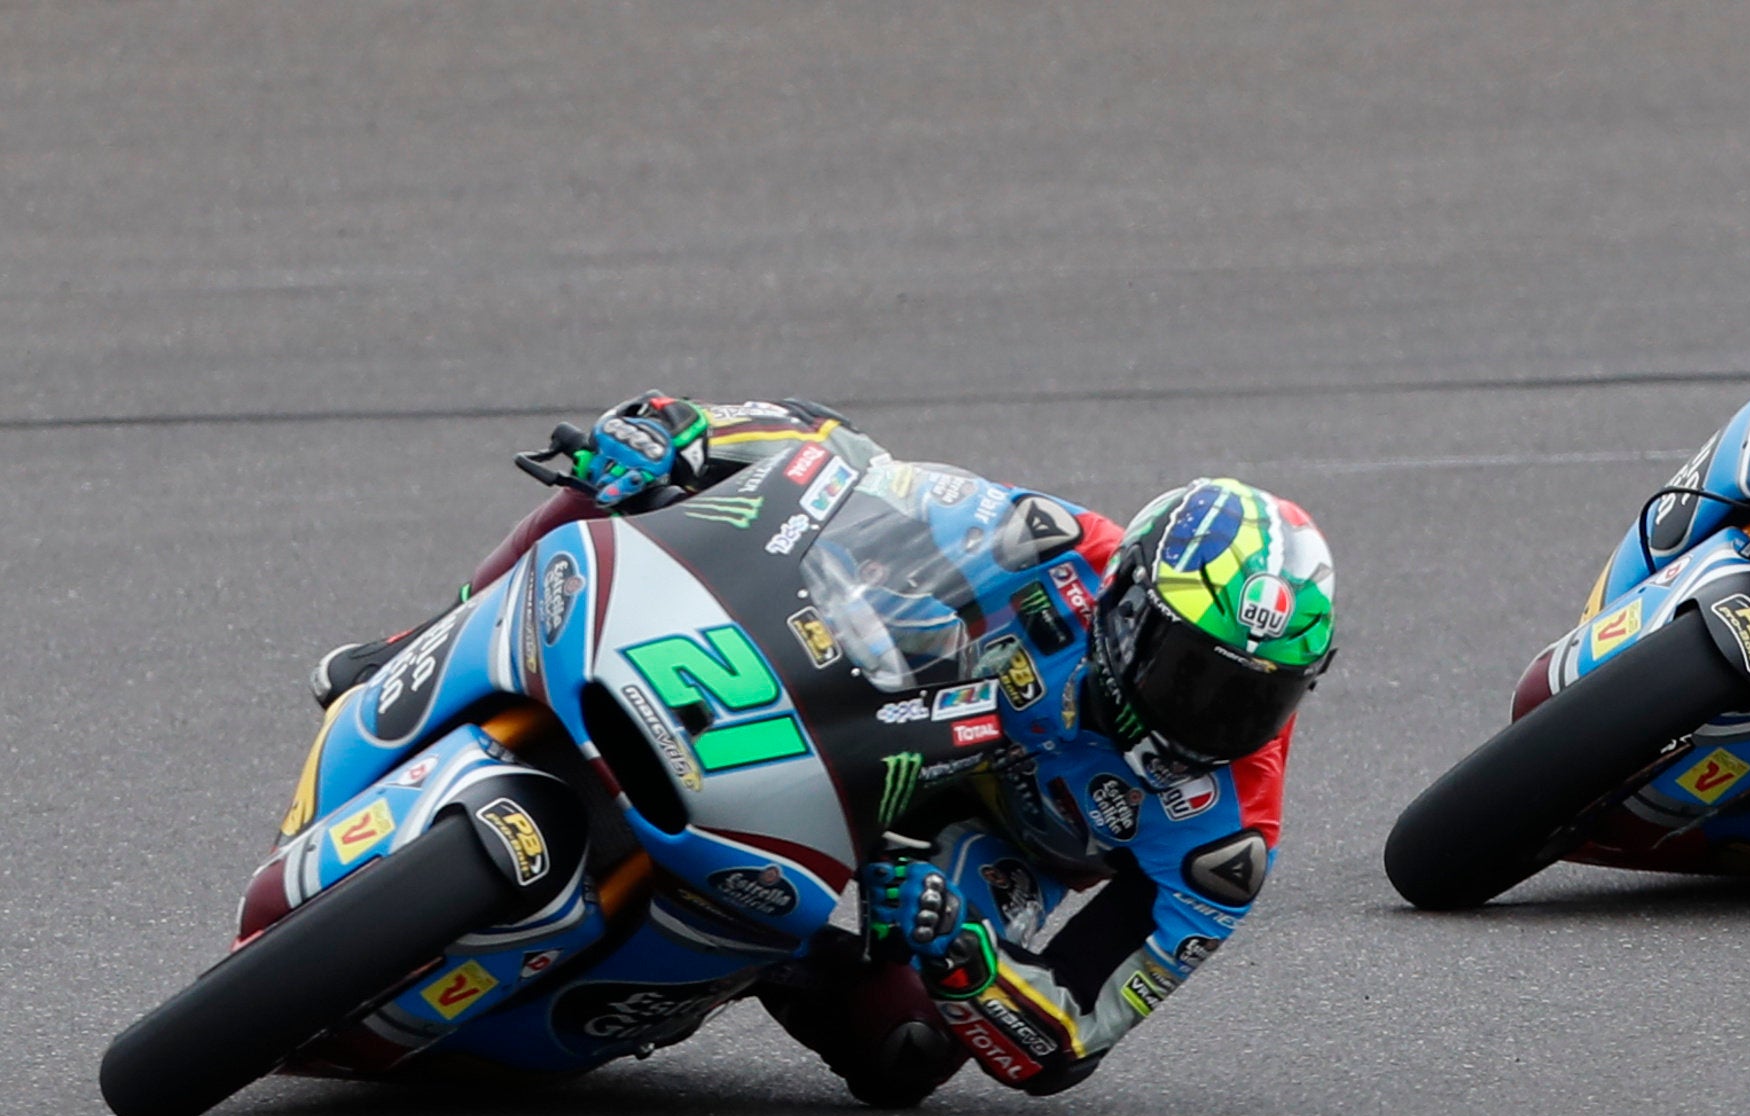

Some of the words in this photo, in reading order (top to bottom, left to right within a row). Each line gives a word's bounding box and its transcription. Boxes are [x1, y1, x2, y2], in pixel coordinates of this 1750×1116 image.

[620, 624, 812, 775] 21
[953, 723, 1000, 742] TOTAL
[503, 812, 543, 857] PB
[966, 1024, 1022, 1080] TOTAL
